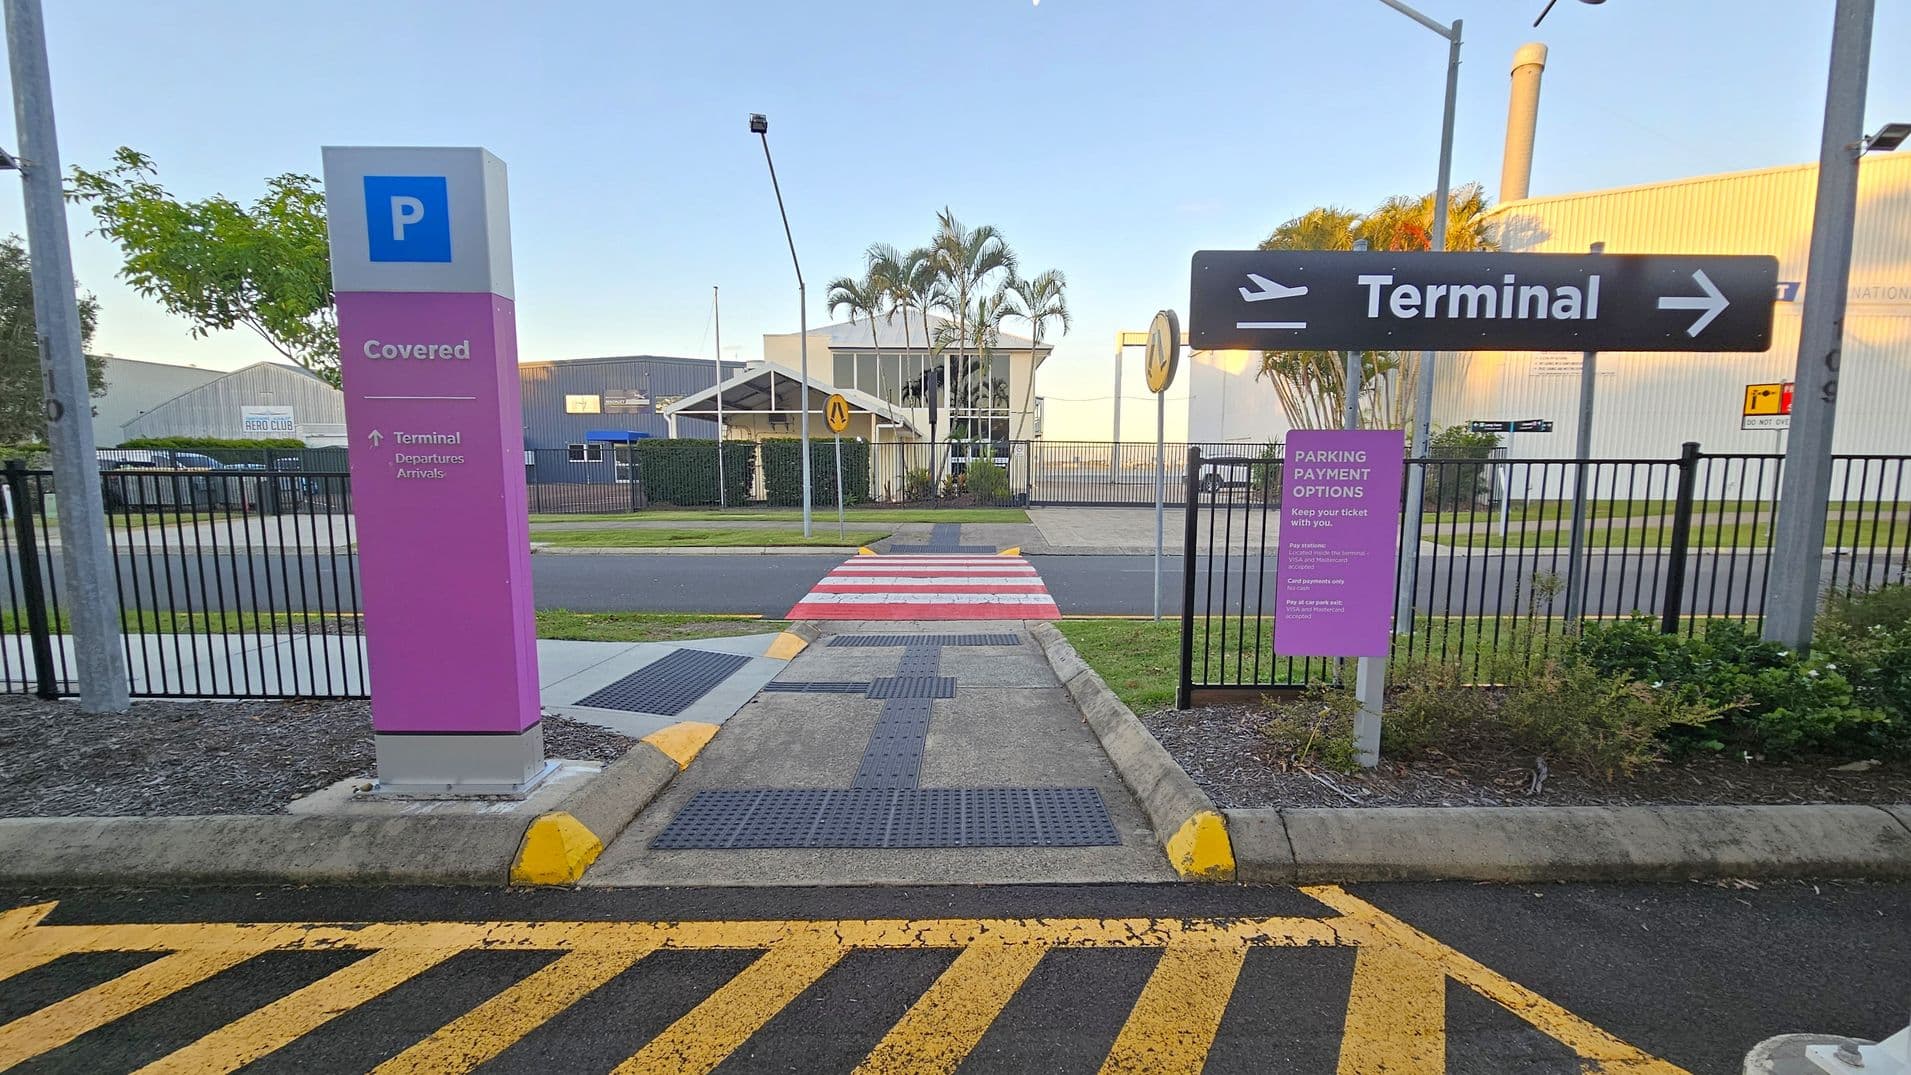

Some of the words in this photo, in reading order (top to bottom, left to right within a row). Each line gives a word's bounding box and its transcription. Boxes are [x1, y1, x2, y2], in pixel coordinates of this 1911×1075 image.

[390, 195, 425, 241] P
[1357, 273, 1600, 321] Terminal
[1851, 286, 1911, 300] NATION
[363, 340, 470, 360] Covered
[245, 420, 269, 431] AERO
[270, 420, 293, 431] CLUB
[1746, 418, 1757, 426] DO
[1759, 418, 1773, 426] NOT
[393, 431, 461, 445] Terminal
[395, 453, 465, 465] Departures
[1295, 450, 1367, 463] PARKING
[397, 468, 444, 479] Arrivals
[1294, 468, 1371, 481] PAYMENT
[1293, 486, 1364, 498] OPTIONS
[1291, 508, 1316, 517] Keep
[1317, 509, 1339, 517] your
[1341, 508, 1368, 517] ticket
[1291, 518, 1311, 527] with
[1313, 519, 1333, 528] you.
